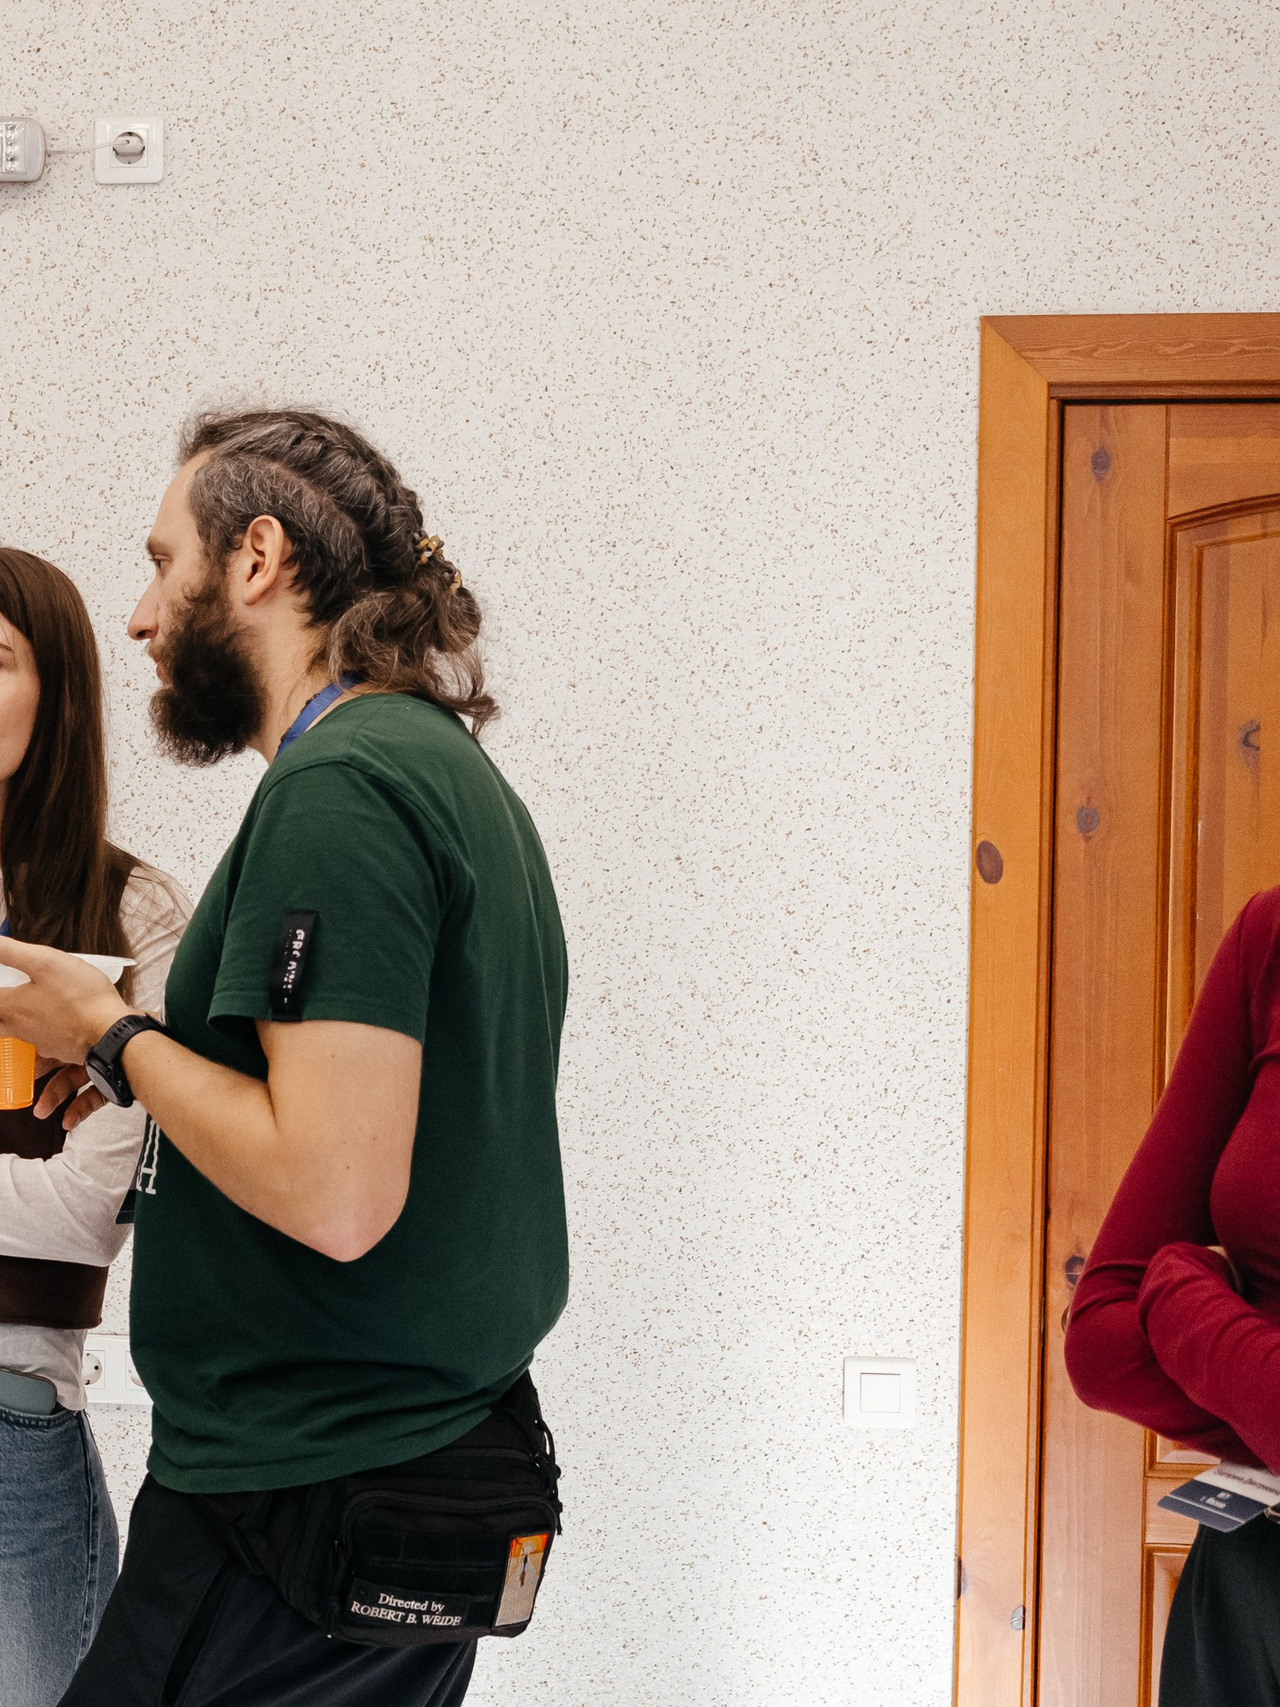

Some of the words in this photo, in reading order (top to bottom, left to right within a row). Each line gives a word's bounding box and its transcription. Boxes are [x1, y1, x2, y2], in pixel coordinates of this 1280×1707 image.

[350, 1601, 405, 1622] ROBERT
[406, 1614, 417, 1624] B.
[422, 1615, 461, 1626] WEIDE
[378, 1593, 428, 1611] Directed
[431, 1601, 445, 1614] by
